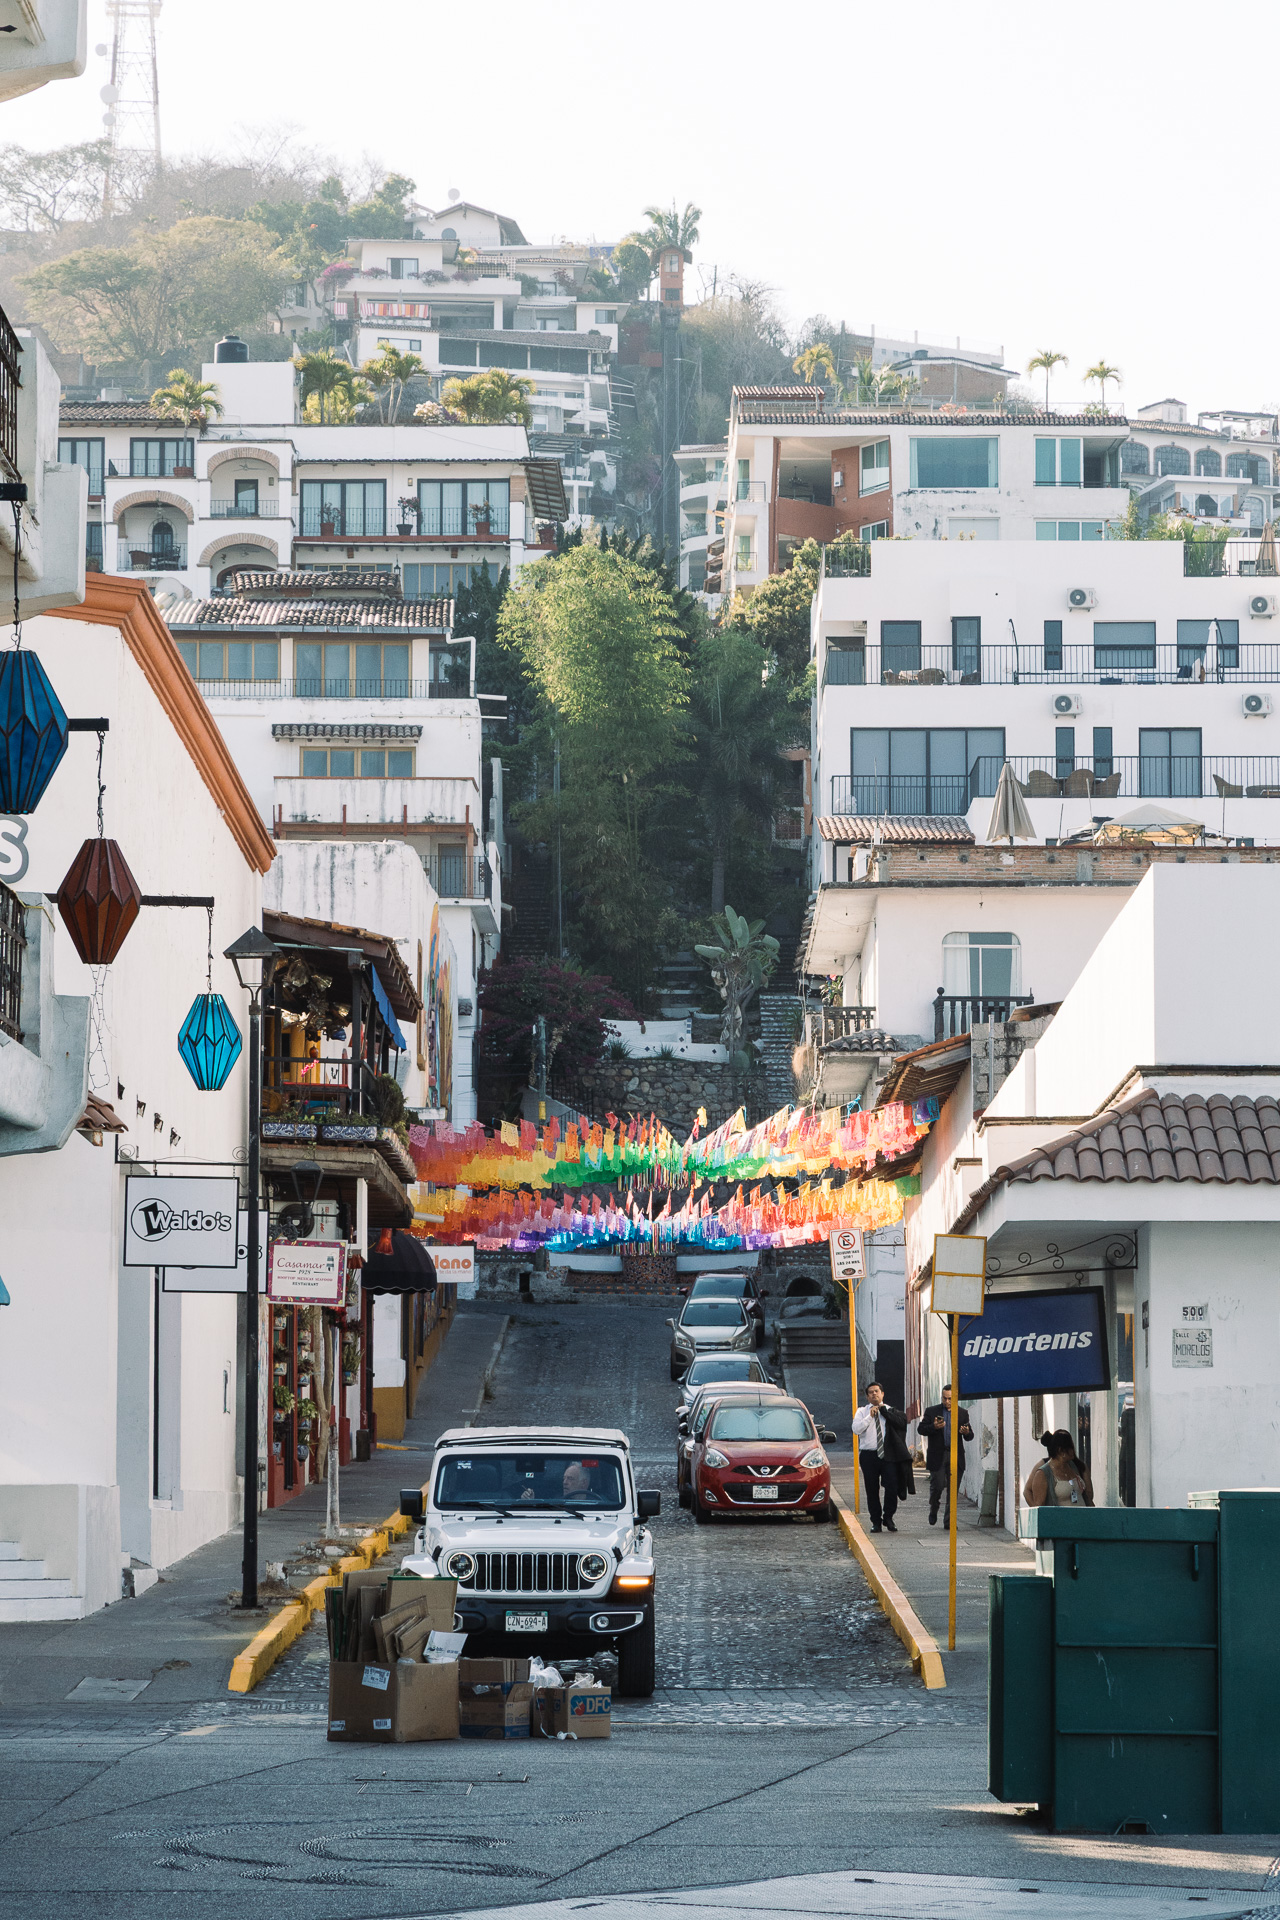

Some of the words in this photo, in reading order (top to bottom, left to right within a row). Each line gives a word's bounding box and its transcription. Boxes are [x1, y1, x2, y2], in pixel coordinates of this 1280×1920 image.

[148, 1209, 232, 1232] Waldo's
[277, 1258, 325, 1269] Casamar
[432, 1255, 472, 1269] lano
[1182, 1306, 1204, 1317] 500
[963, 1331, 1093, 1358] dportenis
[1175, 1344, 1210, 1356] MORELOS
[586, 1697, 611, 1713] DFC
